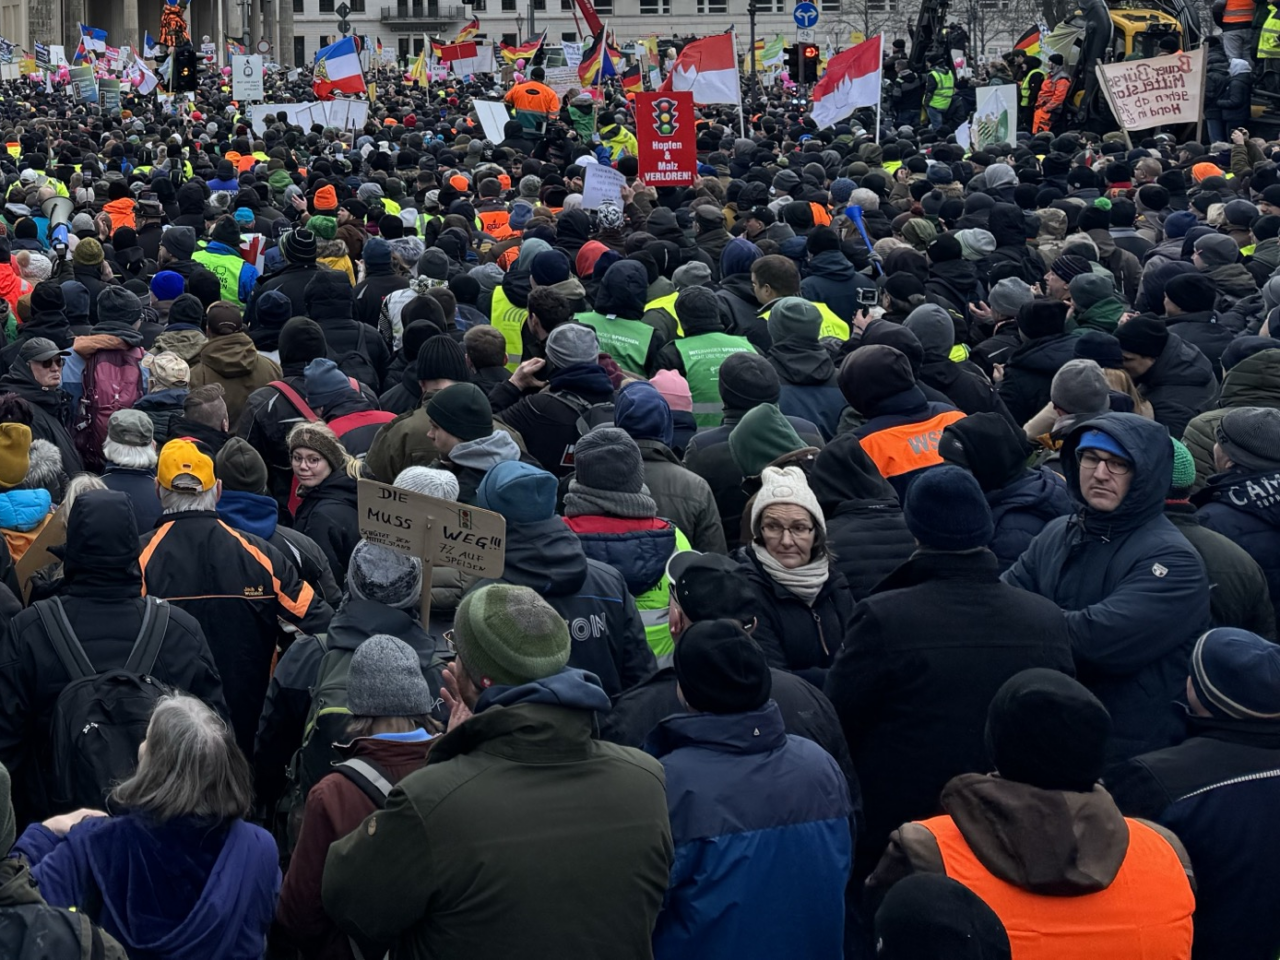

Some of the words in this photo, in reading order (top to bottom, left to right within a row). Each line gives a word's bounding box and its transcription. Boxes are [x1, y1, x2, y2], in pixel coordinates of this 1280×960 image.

[652, 141, 682, 151] Hopfen
[664, 151, 671, 160] &
[658, 161, 678, 171] Malz
[645, 172, 692, 181] VERLOREN!
[611, 334, 640, 346] SPRECHEN
[908, 429, 944, 455] WS
[377, 487, 409, 504] DIE
[1228, 473, 1280, 506] CAM
[367, 507, 413, 530] MUSS
[443, 525, 501, 551] WEG!!!
[438, 542, 456, 556] 7%
[459, 551, 485, 562] AUF
[441, 556, 486, 572] SPEISEN
